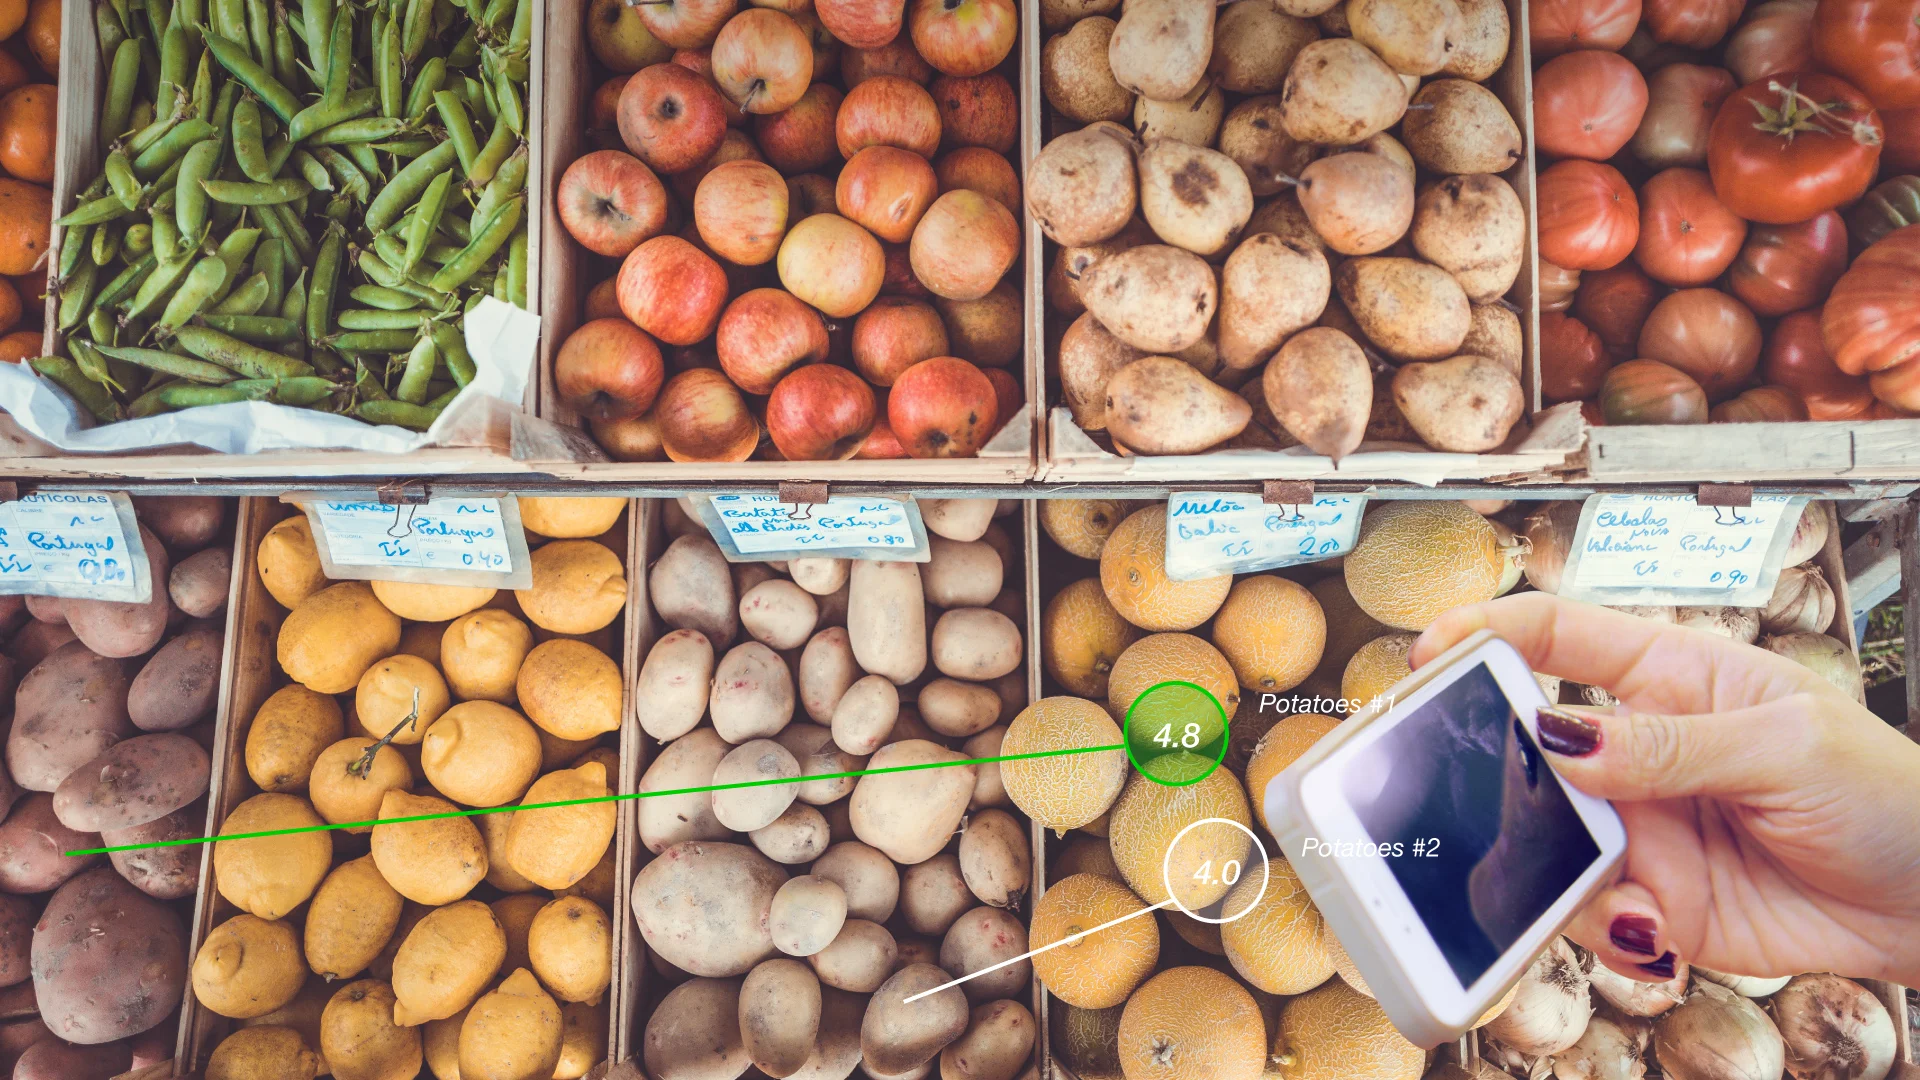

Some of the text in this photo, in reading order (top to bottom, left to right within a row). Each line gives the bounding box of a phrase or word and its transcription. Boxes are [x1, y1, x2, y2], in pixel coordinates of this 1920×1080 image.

[412, 518, 494, 543] Portugal
[28, 532, 114, 557] Portugal
[1680, 535, 1752, 558] Portugal
